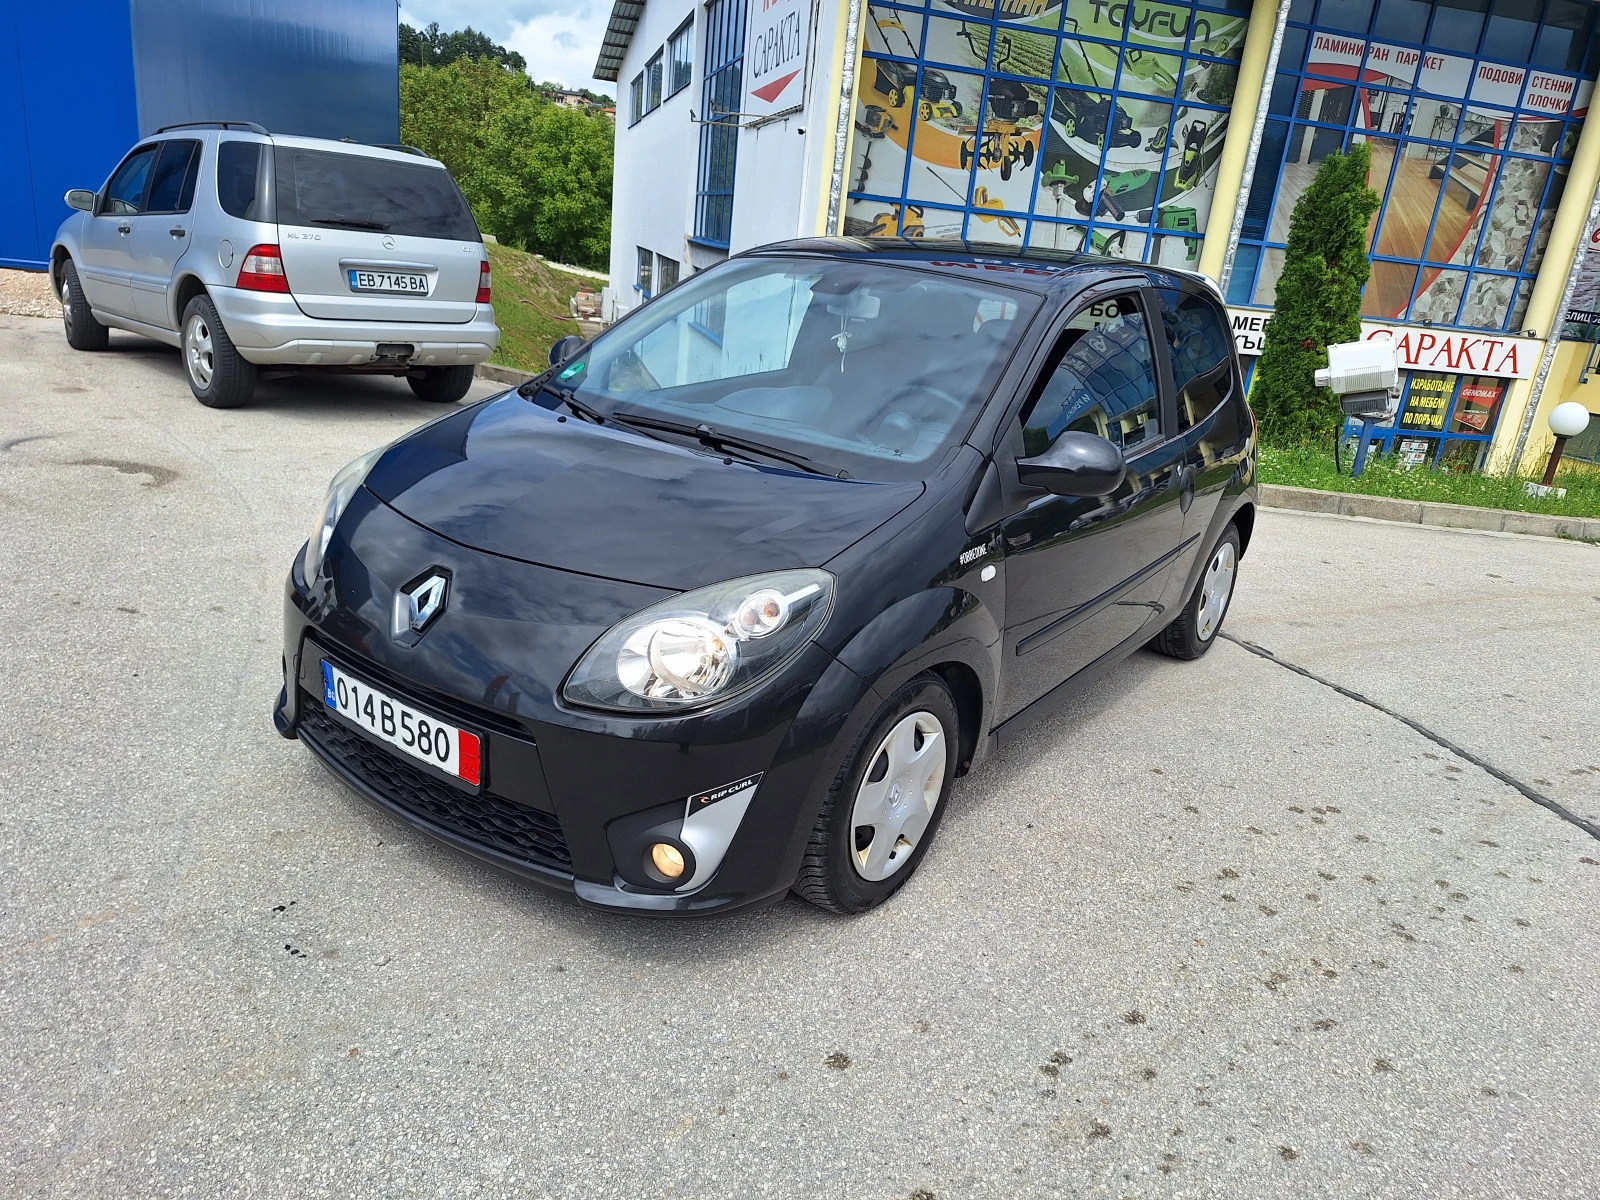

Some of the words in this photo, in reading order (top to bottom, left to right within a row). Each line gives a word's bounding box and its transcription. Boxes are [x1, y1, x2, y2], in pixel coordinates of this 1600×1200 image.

[754, 7, 800, 78] САРАКТА
[1479, 66, 1523, 86] ПОДОВИ
[1531, 75, 1573, 94] СТЕННИ
[1527, 93, 1571, 112] ПЛОЧКИ
[377, 274, 408, 289] 7145
[1410, 378, 1456, 393] ИЗРАБОТВАНЕ
[1462, 388, 1499, 398] GENOMAX
[1409, 395, 1419, 407] НА
[1419, 396, 1447, 409] МЕБЕЛИ
[1403, 412, 1413, 424] ПО
[1413, 413, 1443, 426] ПОРЪЧКА
[327, 687, 336, 701] BG
[711, 790, 728, 800] RIP
[728, 779, 754, 794] CURL
